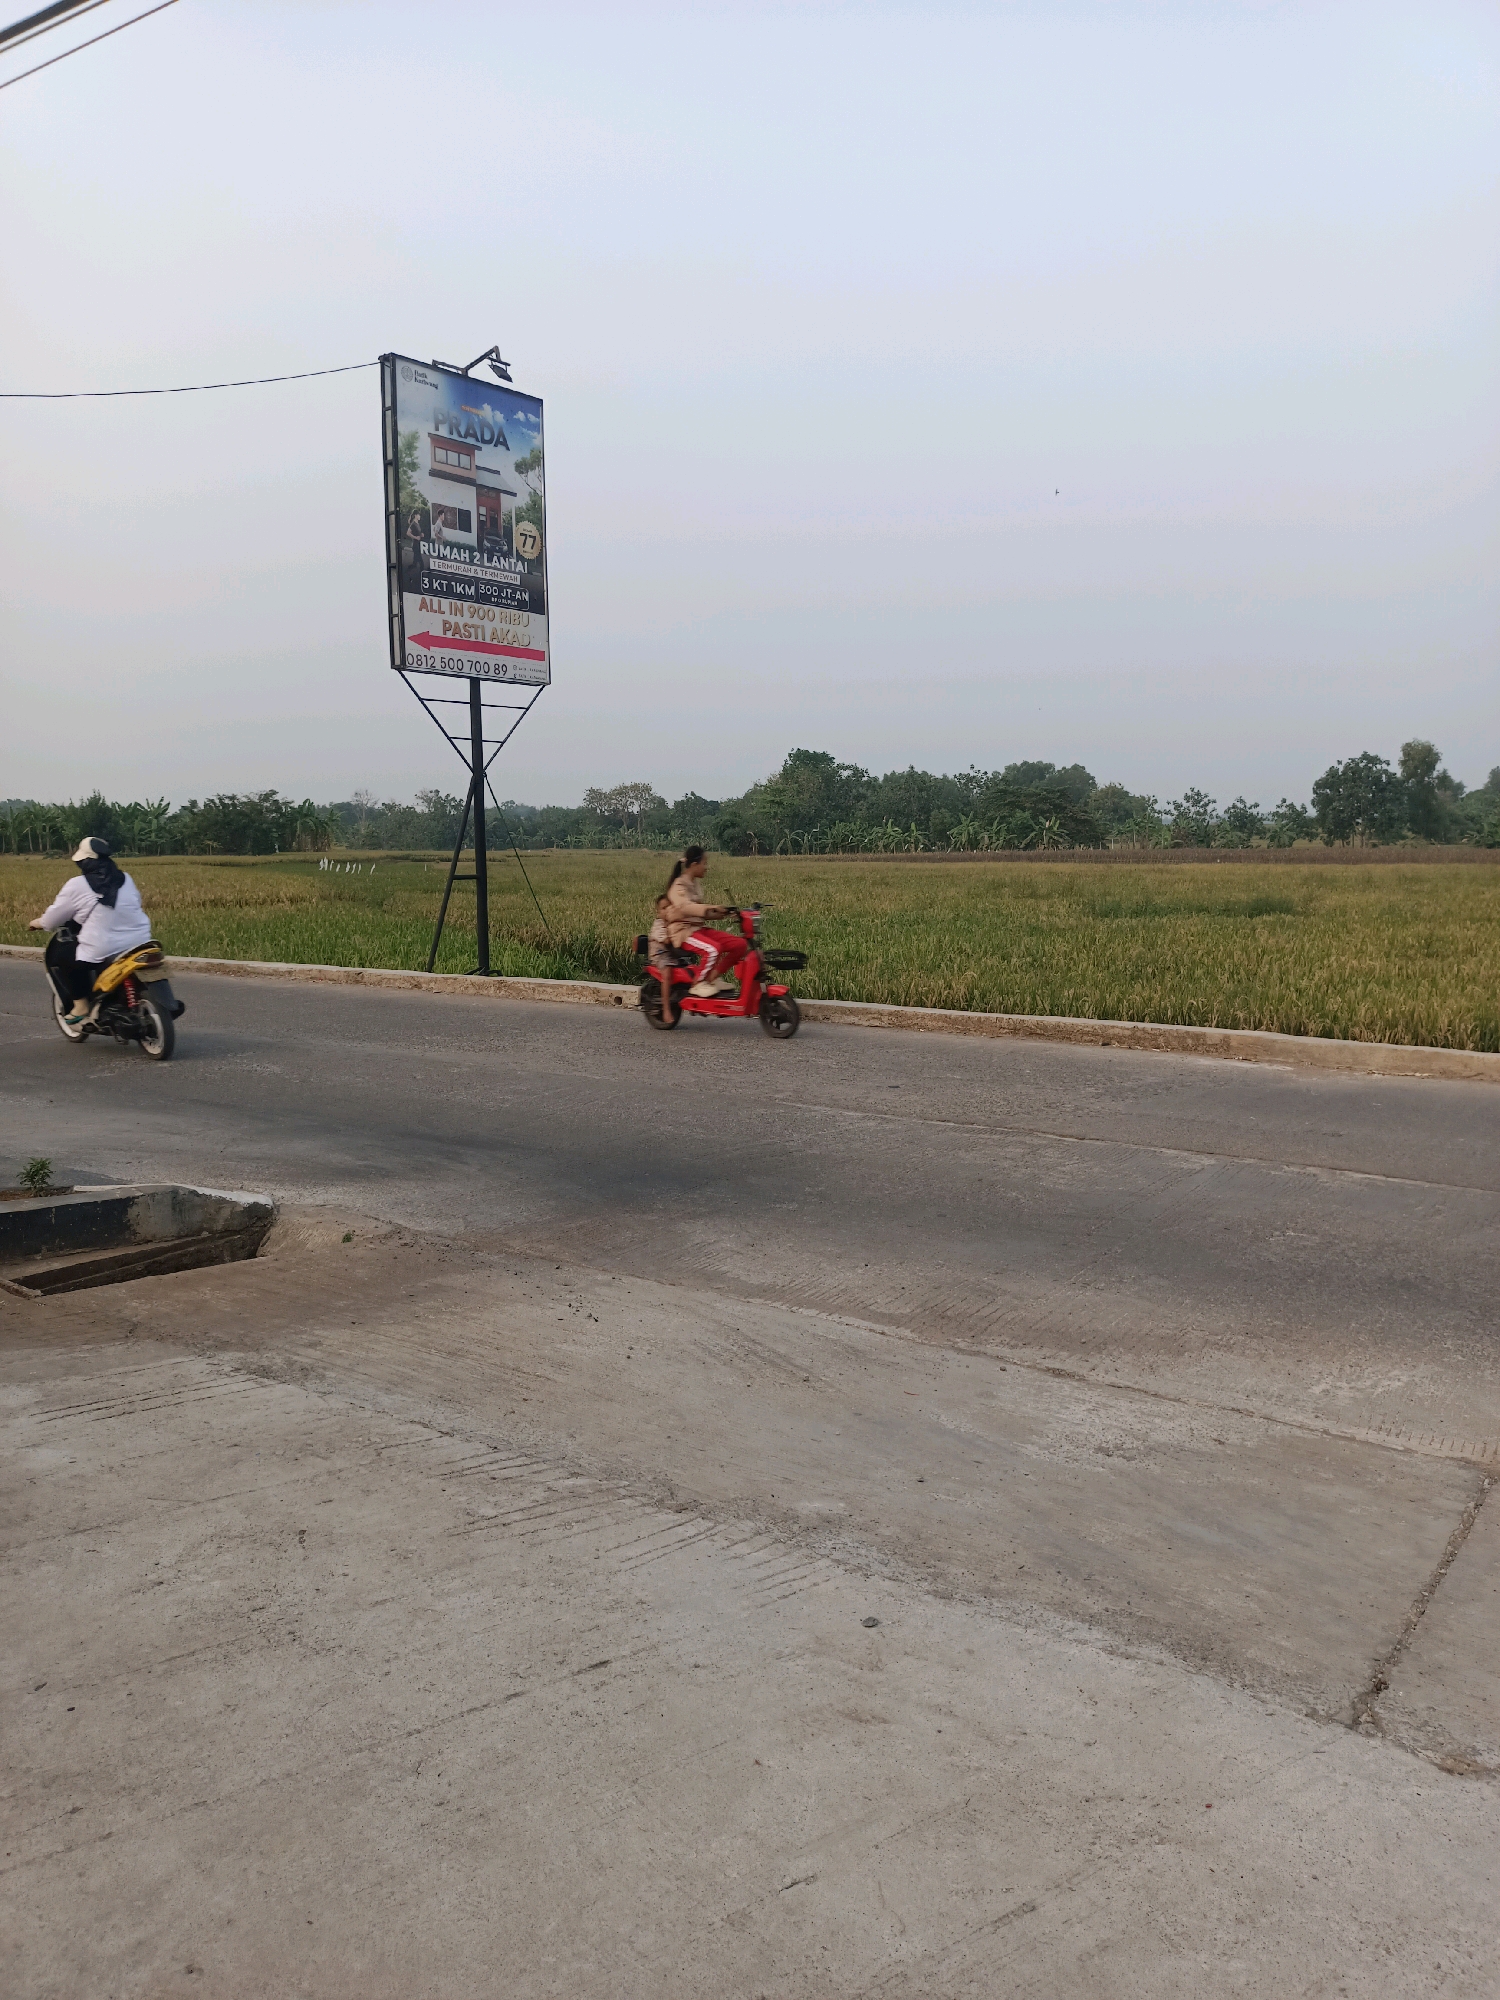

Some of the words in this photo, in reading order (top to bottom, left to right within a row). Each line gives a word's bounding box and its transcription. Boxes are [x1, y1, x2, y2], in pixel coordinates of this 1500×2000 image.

[434, 407, 511, 452] PRADA
[520, 533, 537, 550] 77
[420, 541, 470, 562] RUMAH
[473, 551, 481, 565] 2
[483, 553, 528, 574] LANTAI
[432, 561, 472, 574] TERMURAH
[474, 568, 479, 576] &
[480, 569, 518, 583] TERMEWAH
[422, 577, 430, 589] 3
[432, 578, 448, 591] KT
[452, 582, 475, 596] 1KM
[480, 584, 499, 596] 300
[501, 588, 529, 602] JT-AN
[419, 597, 445, 615] ALL
[449, 601, 464, 618] IN
[467, 604, 496, 622] 900
[500, 609, 530, 628] RIBU
[442, 619, 486, 641] PASTI
[490, 627, 531, 647] AKAD
[406, 653, 436, 669] 0812
[440, 657, 464, 672] 500
[467, 660, 490, 674] 700
[493, 663, 508, 676] 89
